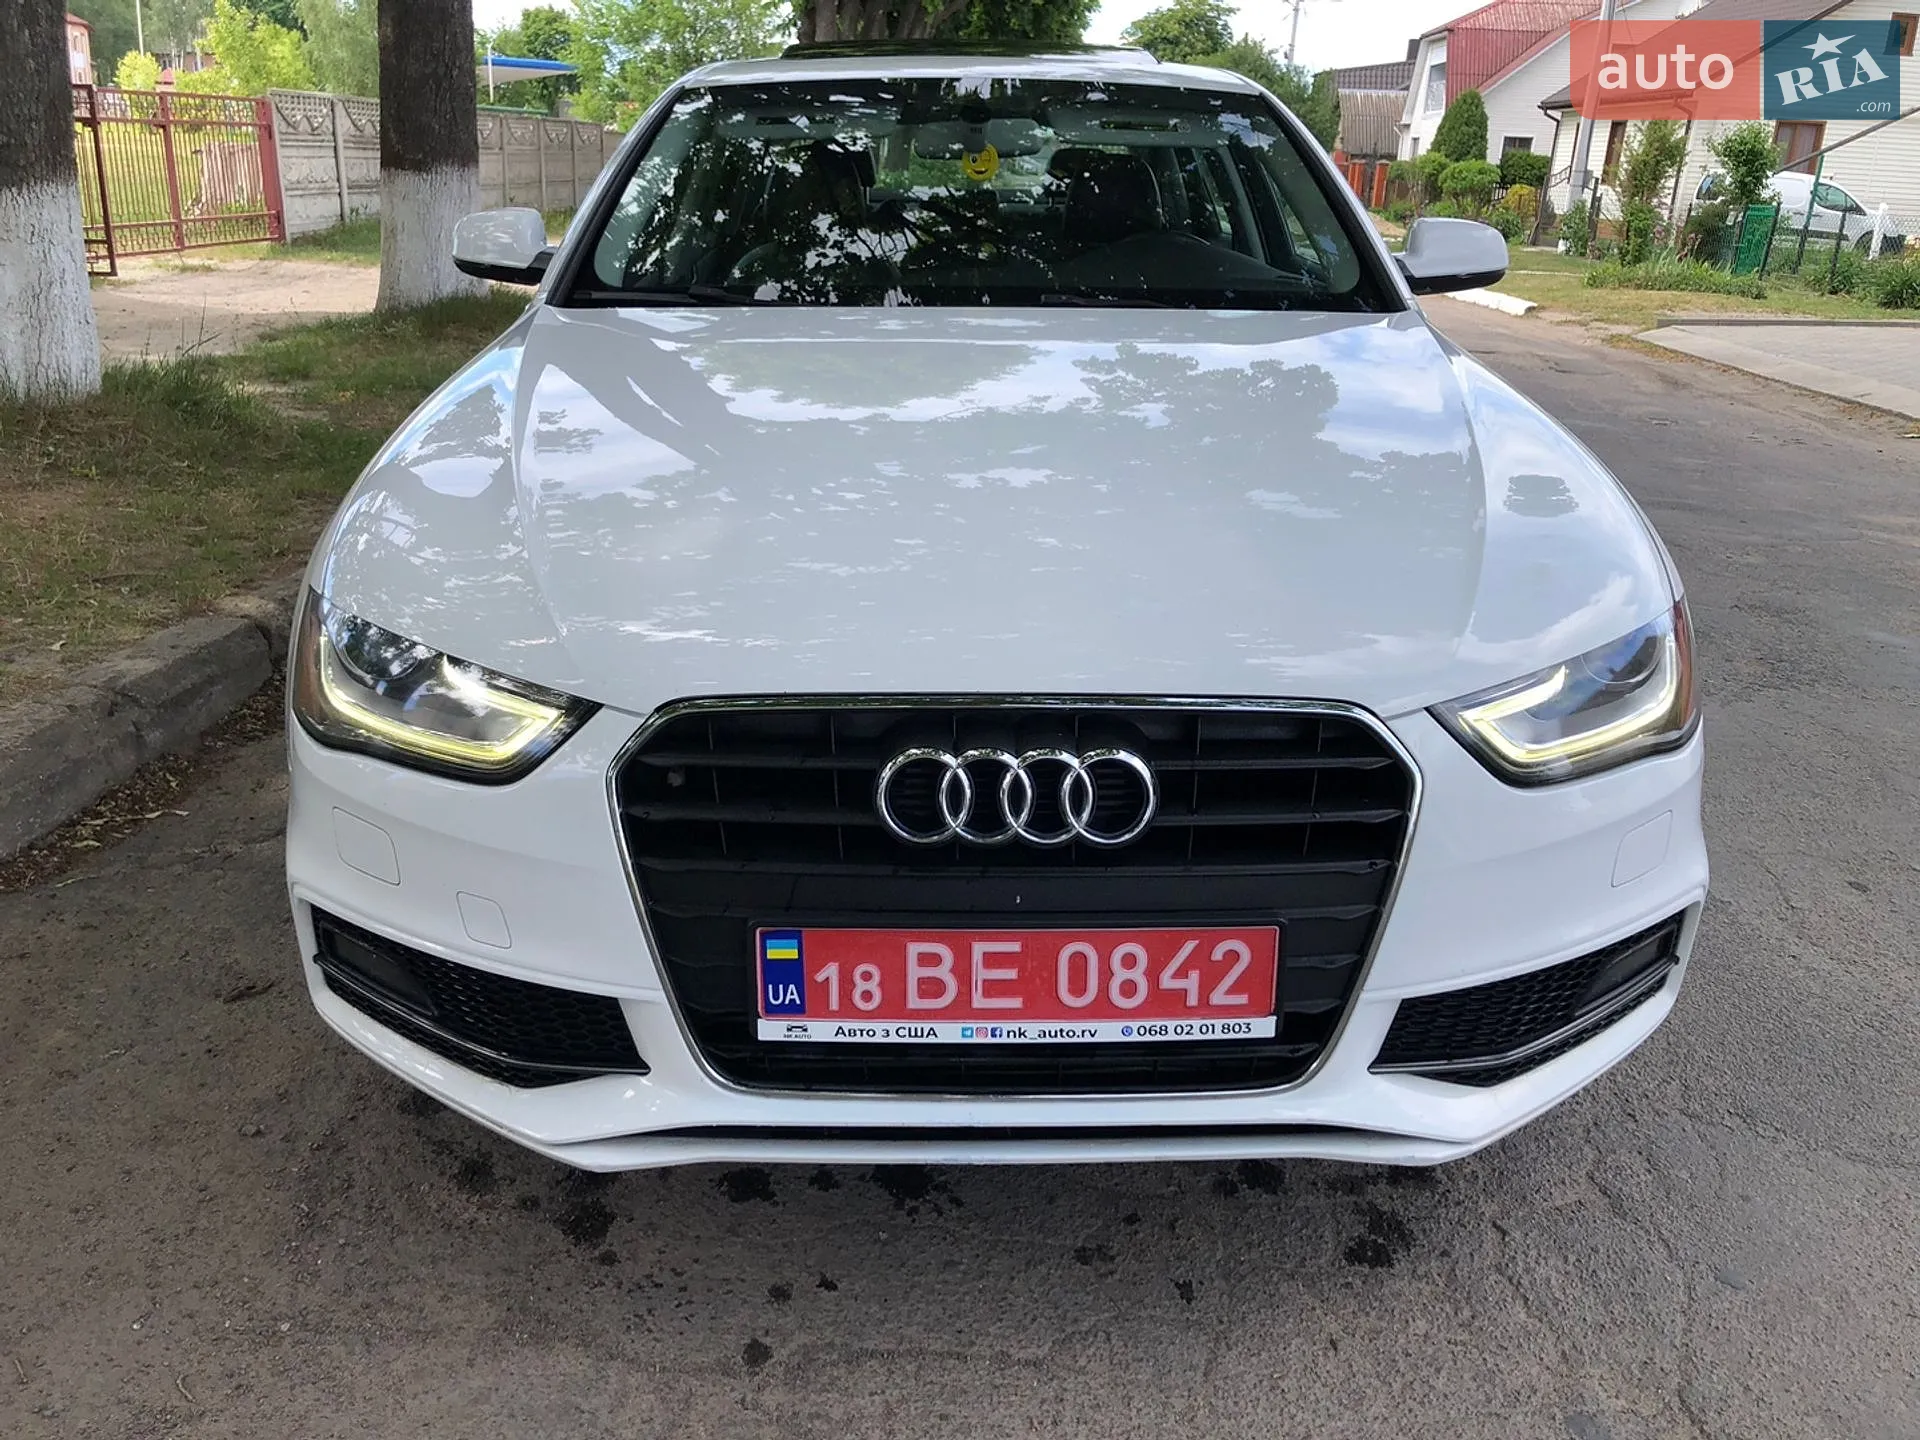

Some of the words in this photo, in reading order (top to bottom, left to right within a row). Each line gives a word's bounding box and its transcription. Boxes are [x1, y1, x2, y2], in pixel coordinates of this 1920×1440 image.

[813, 962, 882, 1012] 18
[905, 941, 1023, 1010] BE
[1056, 939, 1252, 1010] 0842
[768, 984, 801, 1005] UA
[834, 1025, 876, 1038] Авто
[895, 1026, 938, 1039] США
[1006, 1027, 1098, 1040] nk_auto.rv
[1136, 1024, 1168, 1037] 068
[1174, 1024, 1194, 1036] 02
[1199, 1023, 1215, 1035] 01
[1221, 1022, 1252, 1035] 803
